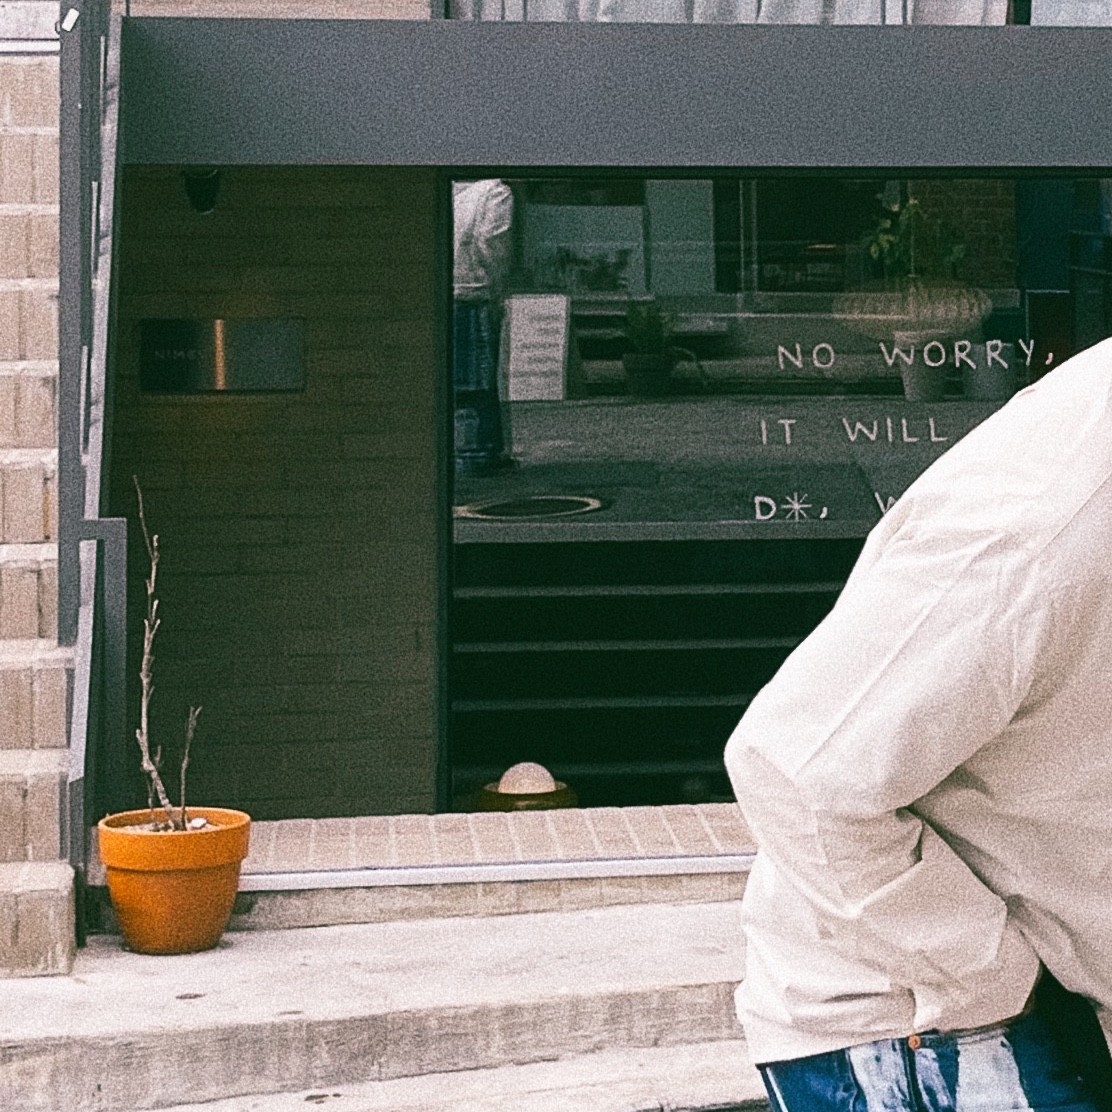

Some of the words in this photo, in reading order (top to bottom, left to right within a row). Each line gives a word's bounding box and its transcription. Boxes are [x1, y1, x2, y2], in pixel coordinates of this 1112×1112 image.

[777, 343, 835, 370] NO
[879, 339, 1054, 370] WORRY,
[761, 419, 797, 445] IT
[842, 417, 949, 443] WILL
